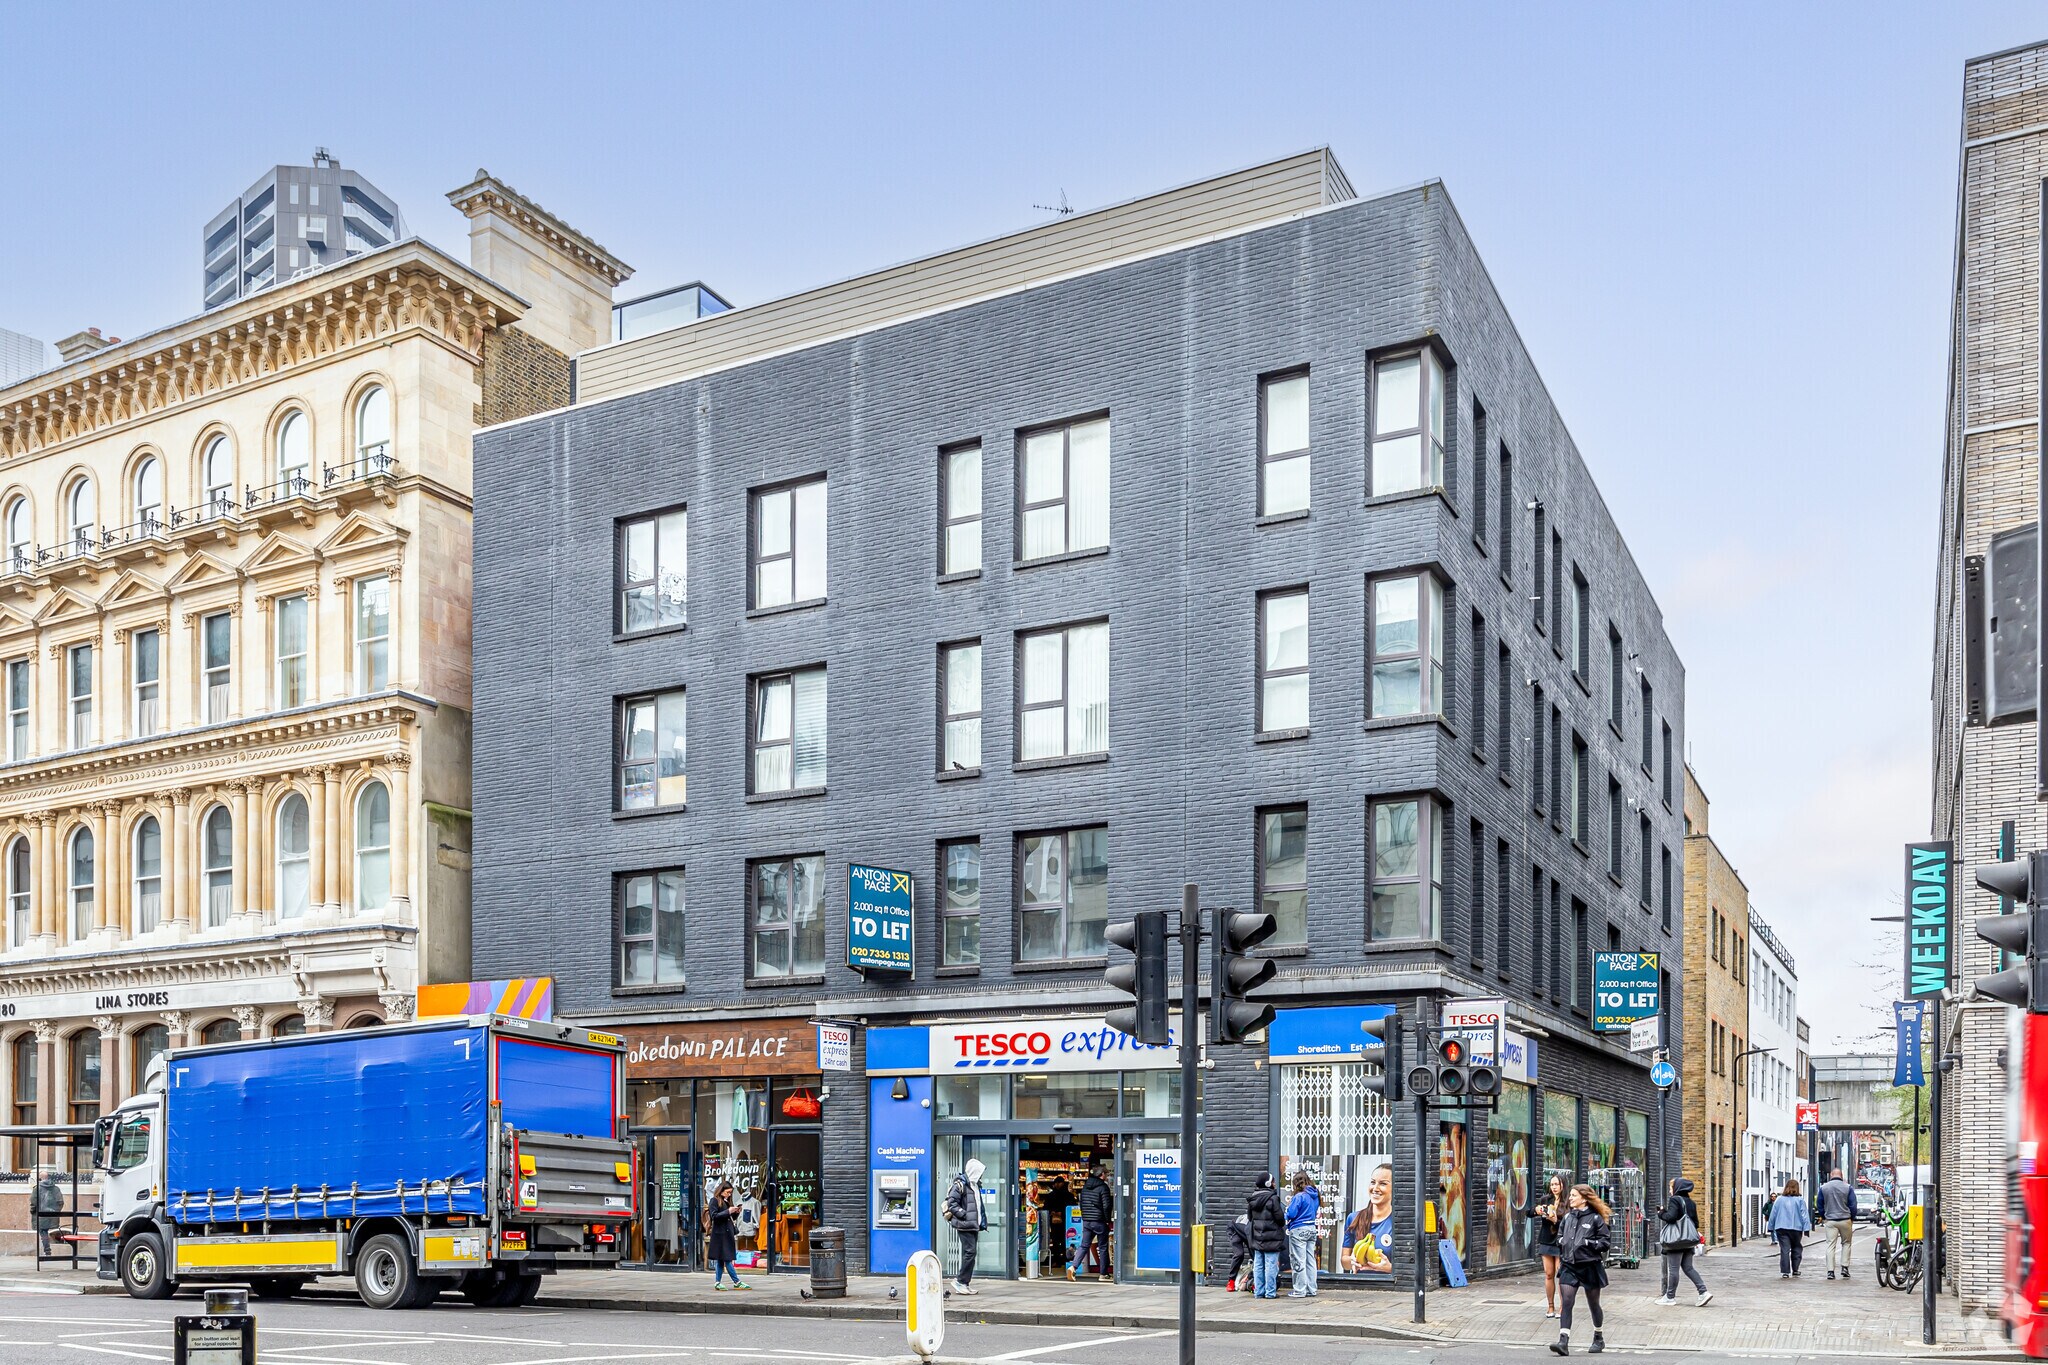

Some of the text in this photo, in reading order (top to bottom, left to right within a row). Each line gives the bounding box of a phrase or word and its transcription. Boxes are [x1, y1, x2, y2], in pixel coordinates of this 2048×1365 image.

[852, 867, 890, 882] ANTON
[864, 880, 890, 893] PAGE
[854, 902, 910, 917] 2,000 sq ft Office
[1911, 847, 1947, 995] WEEKDAY
[852, 916, 909, 941] TO LET
[852, 947, 910, 961] 020 7336 1313
[1597, 953, 1637, 963] ANTON
[860, 957, 910, 968] antonpage.com
[1610, 962, 1637, 971] PAGE
[1599, 980, 1619, 988] 2,000
[1636, 980, 1658, 988] Office
[0, 991, 169, 1016] 80 LINA STORES
[1598, 992, 1658, 1008] TO LET
[1449, 1013, 1499, 1025] TESCO
[823, 1030, 848, 1042] TESCO
[953, 1026, 1175, 1060] TESCO exprs
[1297, 1044, 1341, 1054] Shoreditch
[1350, 1043, 1363, 1052] Est
[626, 1035, 788, 1064] okedown PALACE
[822, 1046, 848, 1057] express
[836, 1059, 848, 1067] cash
[877, 1147, 925, 1155] Cash Machine
[1143, 1153, 1177, 1165] Hello.
[704, 1161, 759, 1177] Brokedown
[1285, 1160, 1321, 1172] Serving
[704, 1175, 759, 1190] PAACE
[1143, 1183, 1159, 1191] 6am
[1314, 1216, 1338, 1226] etter
